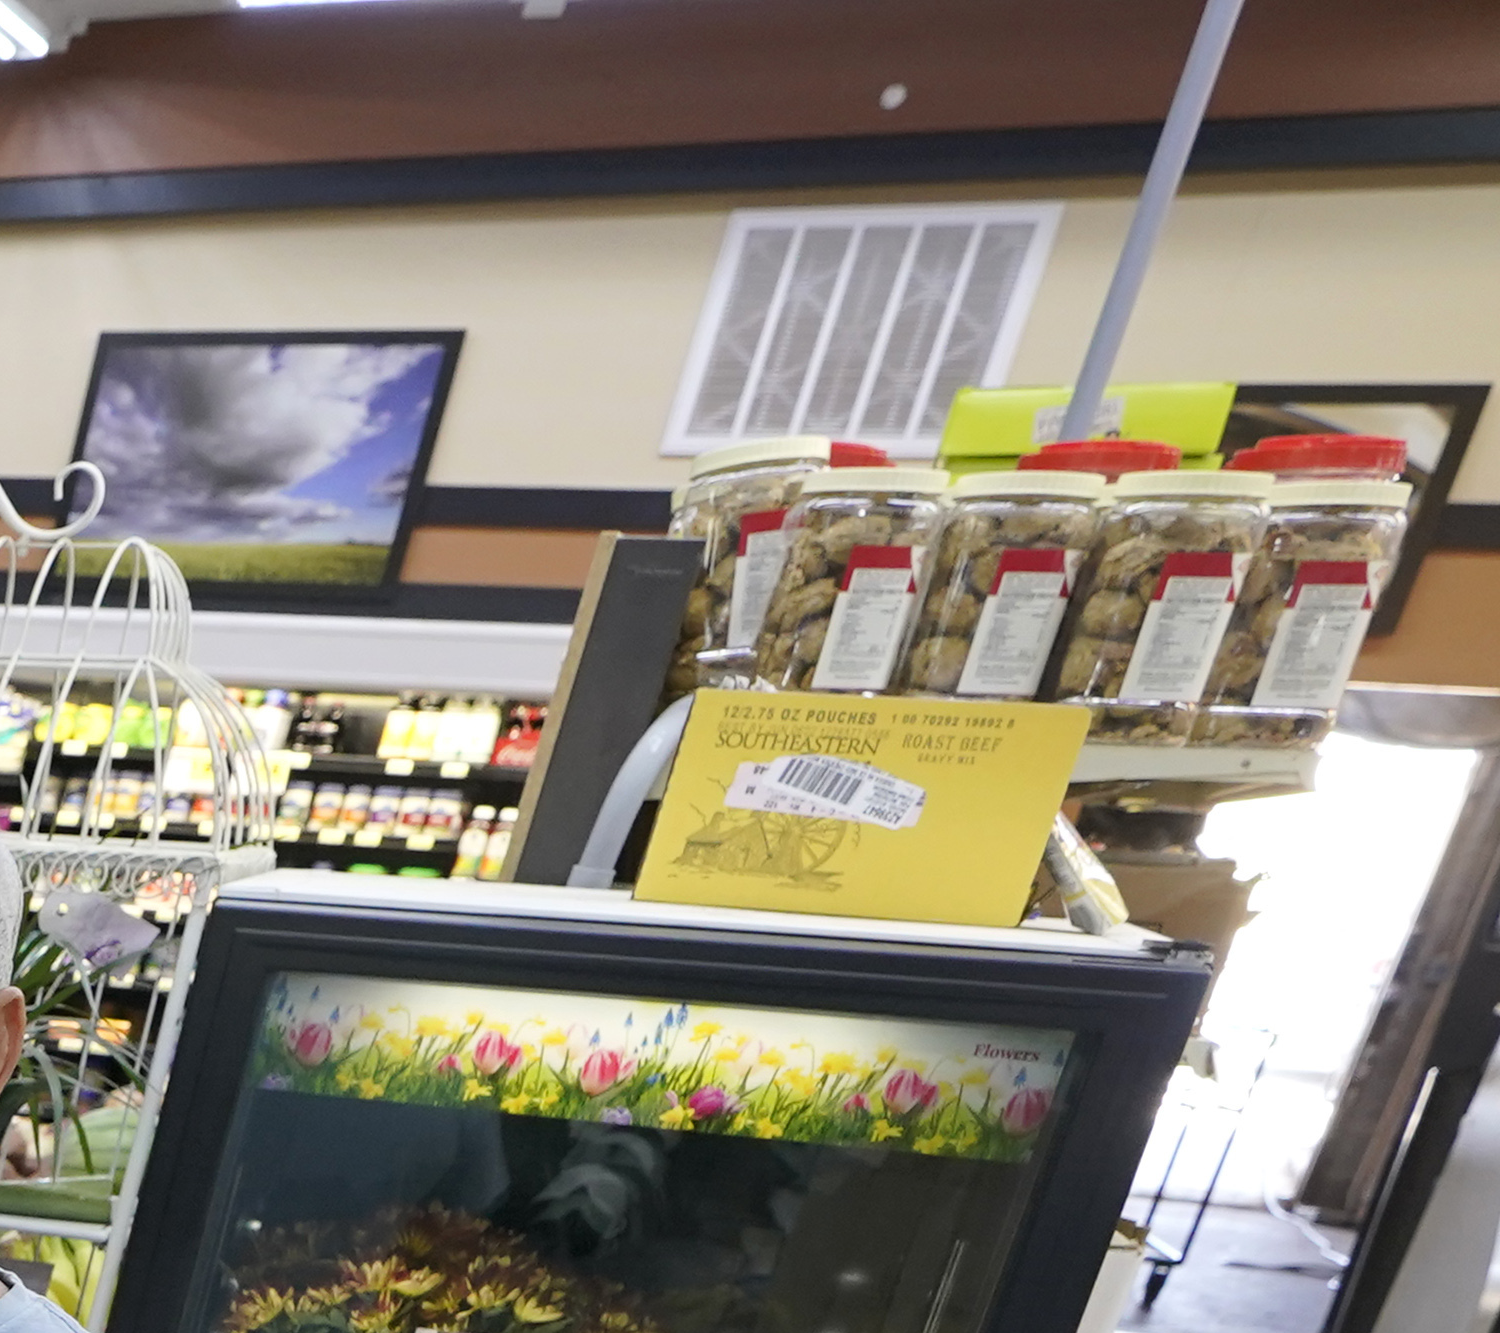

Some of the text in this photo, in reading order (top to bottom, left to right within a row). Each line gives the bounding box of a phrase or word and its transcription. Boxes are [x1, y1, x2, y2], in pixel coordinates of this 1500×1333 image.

[781, 708, 800, 721] OZ
[806, 710, 877, 726] POUCHES
[891, 714, 897, 724] 1
[715, 732, 882, 755] SOUTHEASTERN
[902, 733, 1003, 753] ROAST BEEF
[973, 1043, 1041, 1062] Flowers
